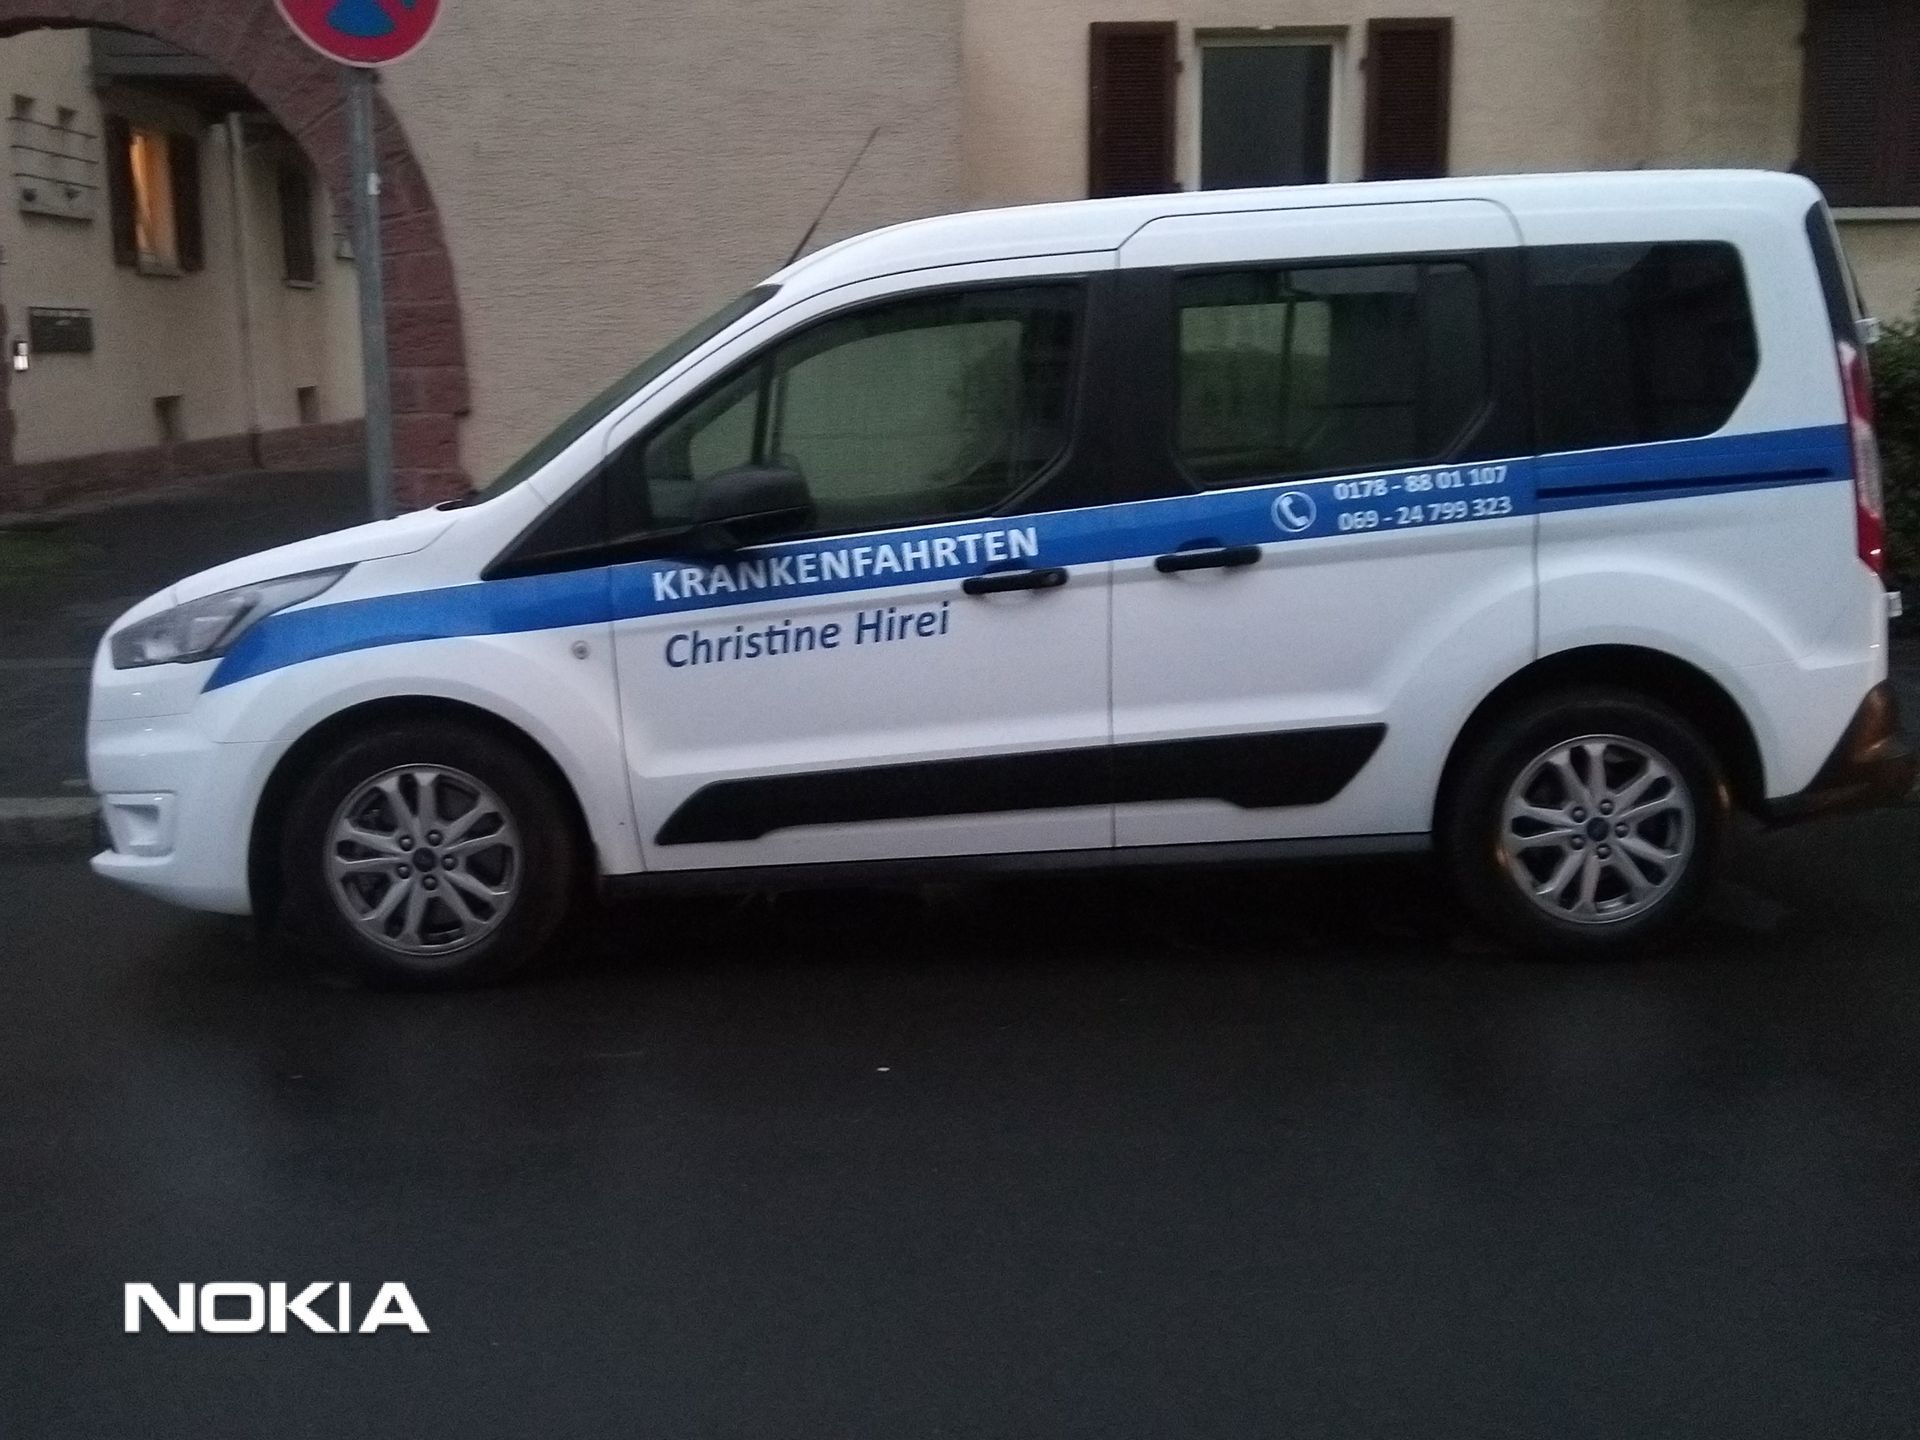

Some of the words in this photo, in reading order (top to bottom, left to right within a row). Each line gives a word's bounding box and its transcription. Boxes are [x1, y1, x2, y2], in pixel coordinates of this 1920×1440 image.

[1333, 479, 1388, 500] 0178
[1404, 474, 1433, 492] 88
[1436, 471, 1464, 489] 01
[1469, 466, 1507, 486] 107
[1338, 510, 1379, 531] 069
[1396, 506, 1424, 525] 24
[1427, 500, 1468, 521] 799
[1472, 496, 1513, 517] 323
[652, 527, 1039, 601] KRANKENFAHRTEN
[665, 619, 841, 668] Christine
[854, 601, 950, 645] Hirei
